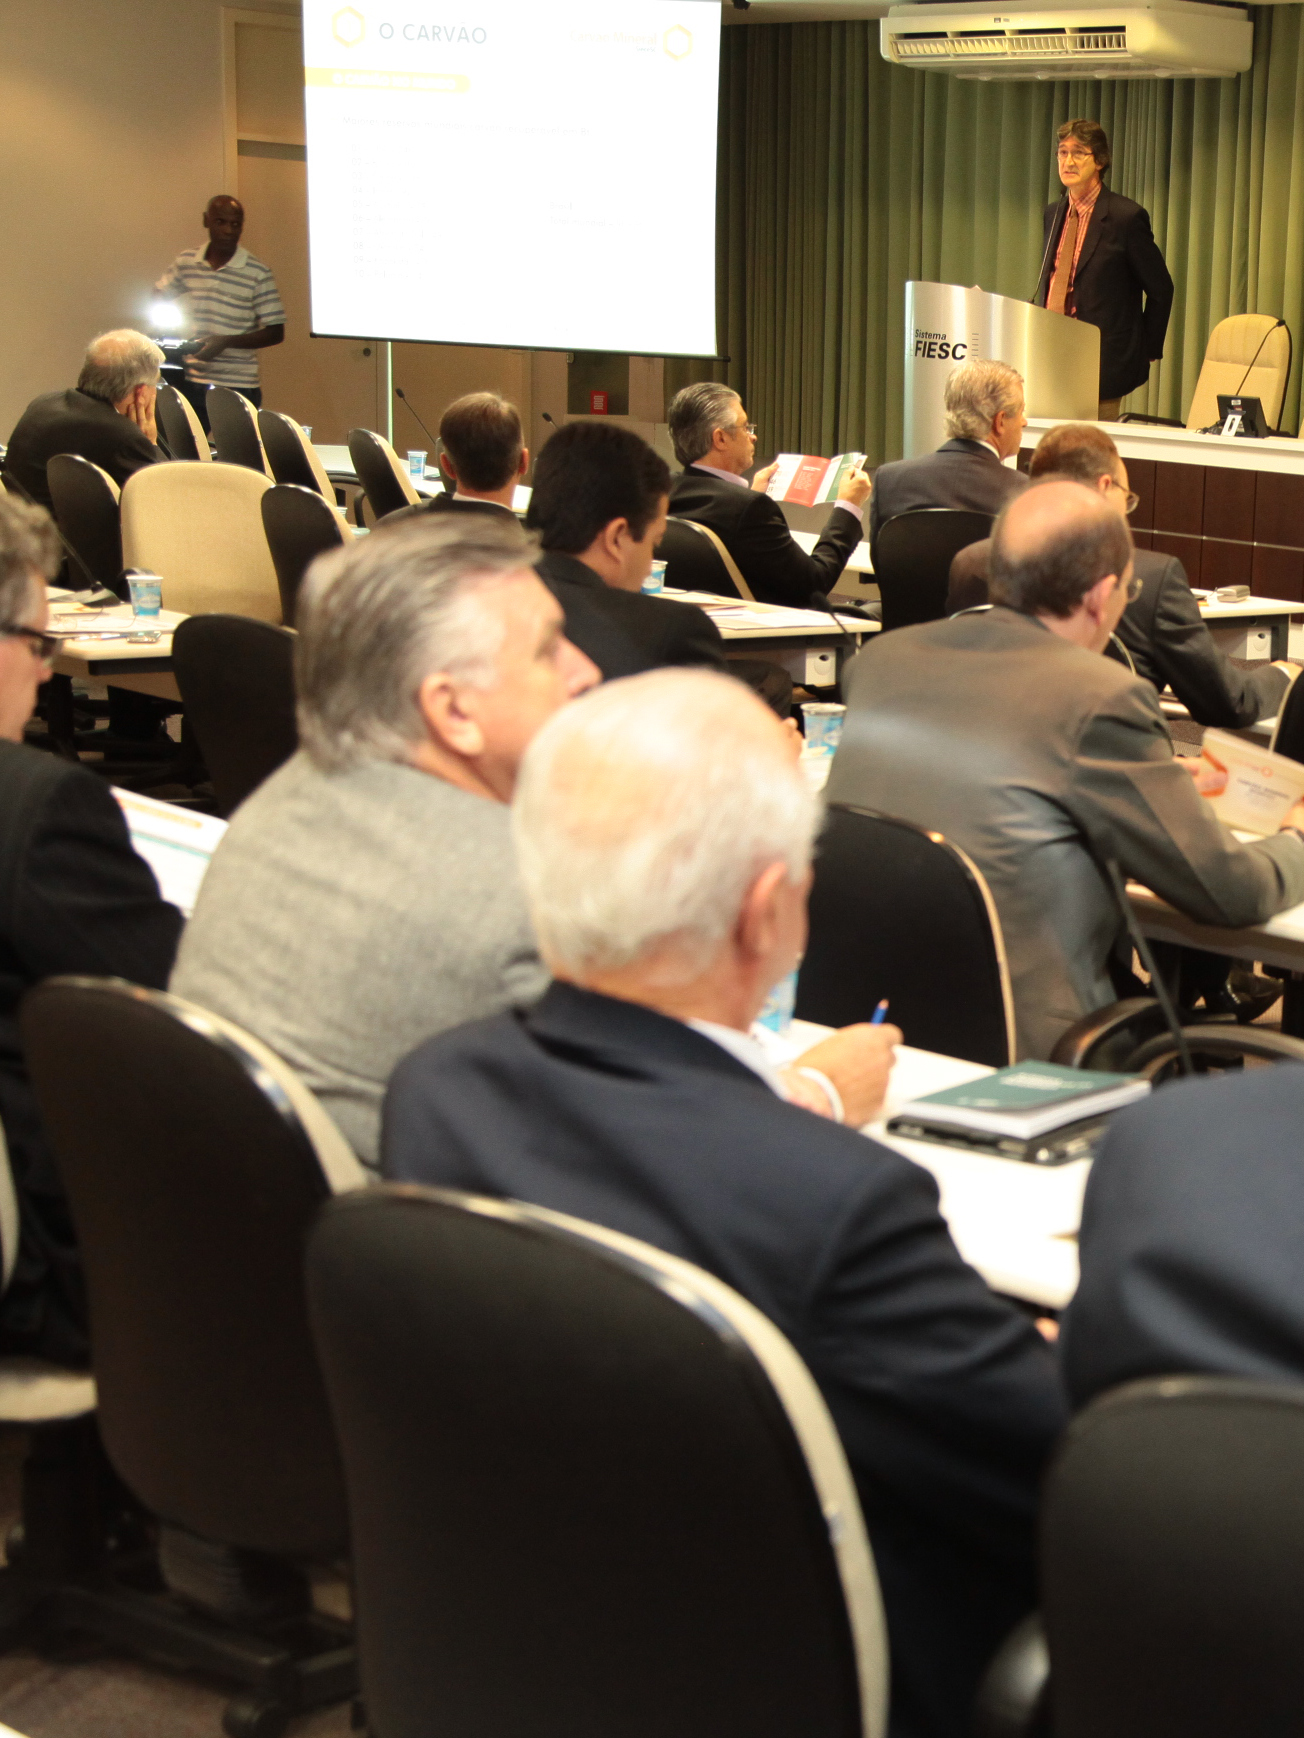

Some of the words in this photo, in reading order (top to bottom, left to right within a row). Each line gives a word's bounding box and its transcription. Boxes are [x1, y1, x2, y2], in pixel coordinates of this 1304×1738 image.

[378, 22, 395, 40] O
[914, 329, 946, 340] Sistema
[914, 340, 967, 360] FIESC
